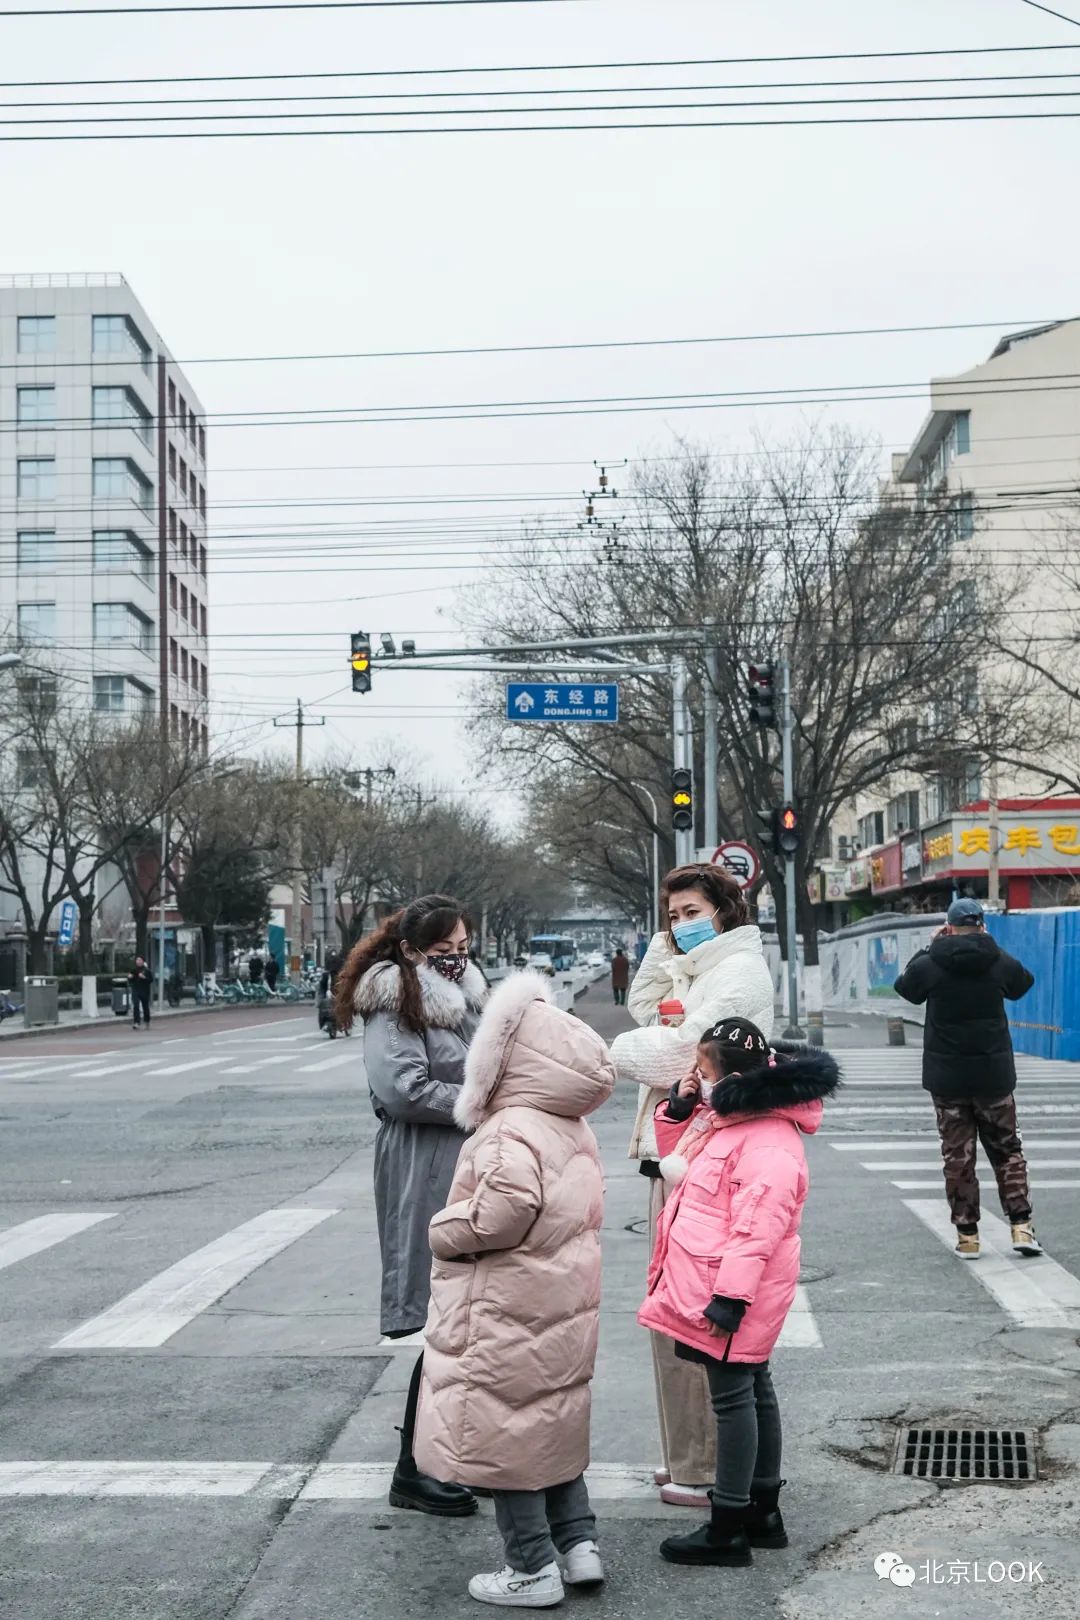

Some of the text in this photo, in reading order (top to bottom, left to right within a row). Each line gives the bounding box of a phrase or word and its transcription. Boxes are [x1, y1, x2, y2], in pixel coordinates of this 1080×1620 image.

[544, 689, 609, 704] 东经路
[543, 708, 592, 716] DONGJING
[958, 825, 1080, 857] 庆丰包
